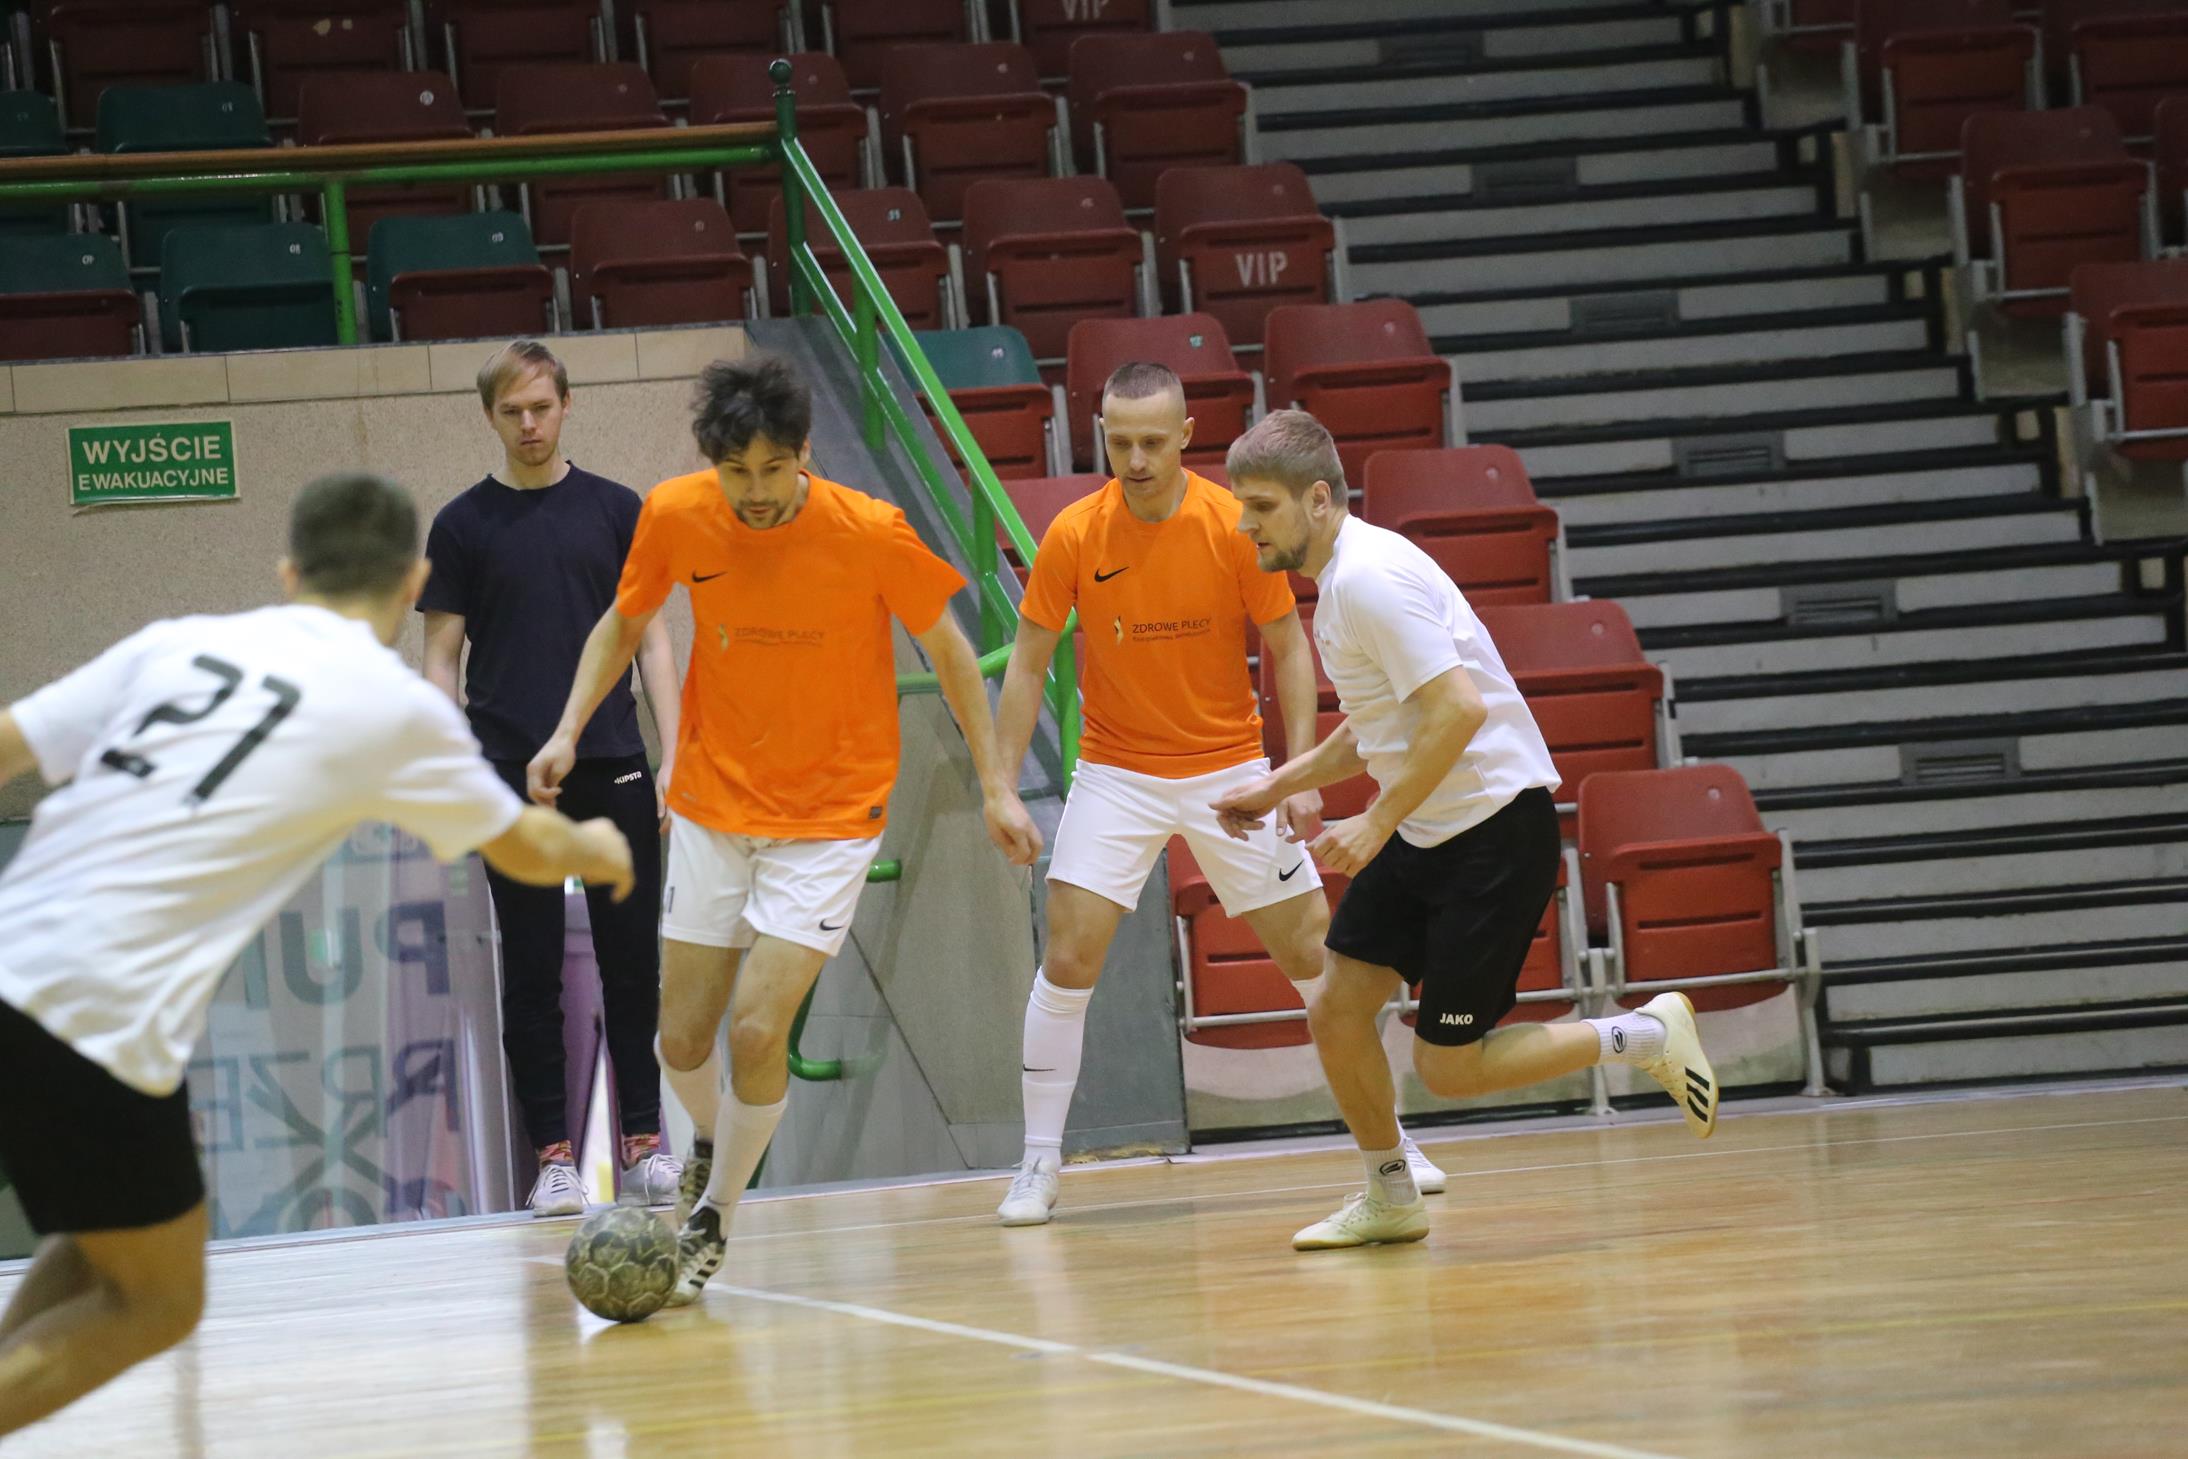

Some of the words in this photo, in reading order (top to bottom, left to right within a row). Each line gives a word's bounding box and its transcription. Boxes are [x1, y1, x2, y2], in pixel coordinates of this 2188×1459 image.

[1235, 251, 1288, 288] VIP
[82, 432, 222, 465] WYJŚCIE
[78, 467, 229, 491] EWAKUACYJNE
[1132, 621, 1179, 634] ZDROWE
[1181, 617, 1212, 630] PLECY
[1440, 1013, 1474, 1025] JAKO
